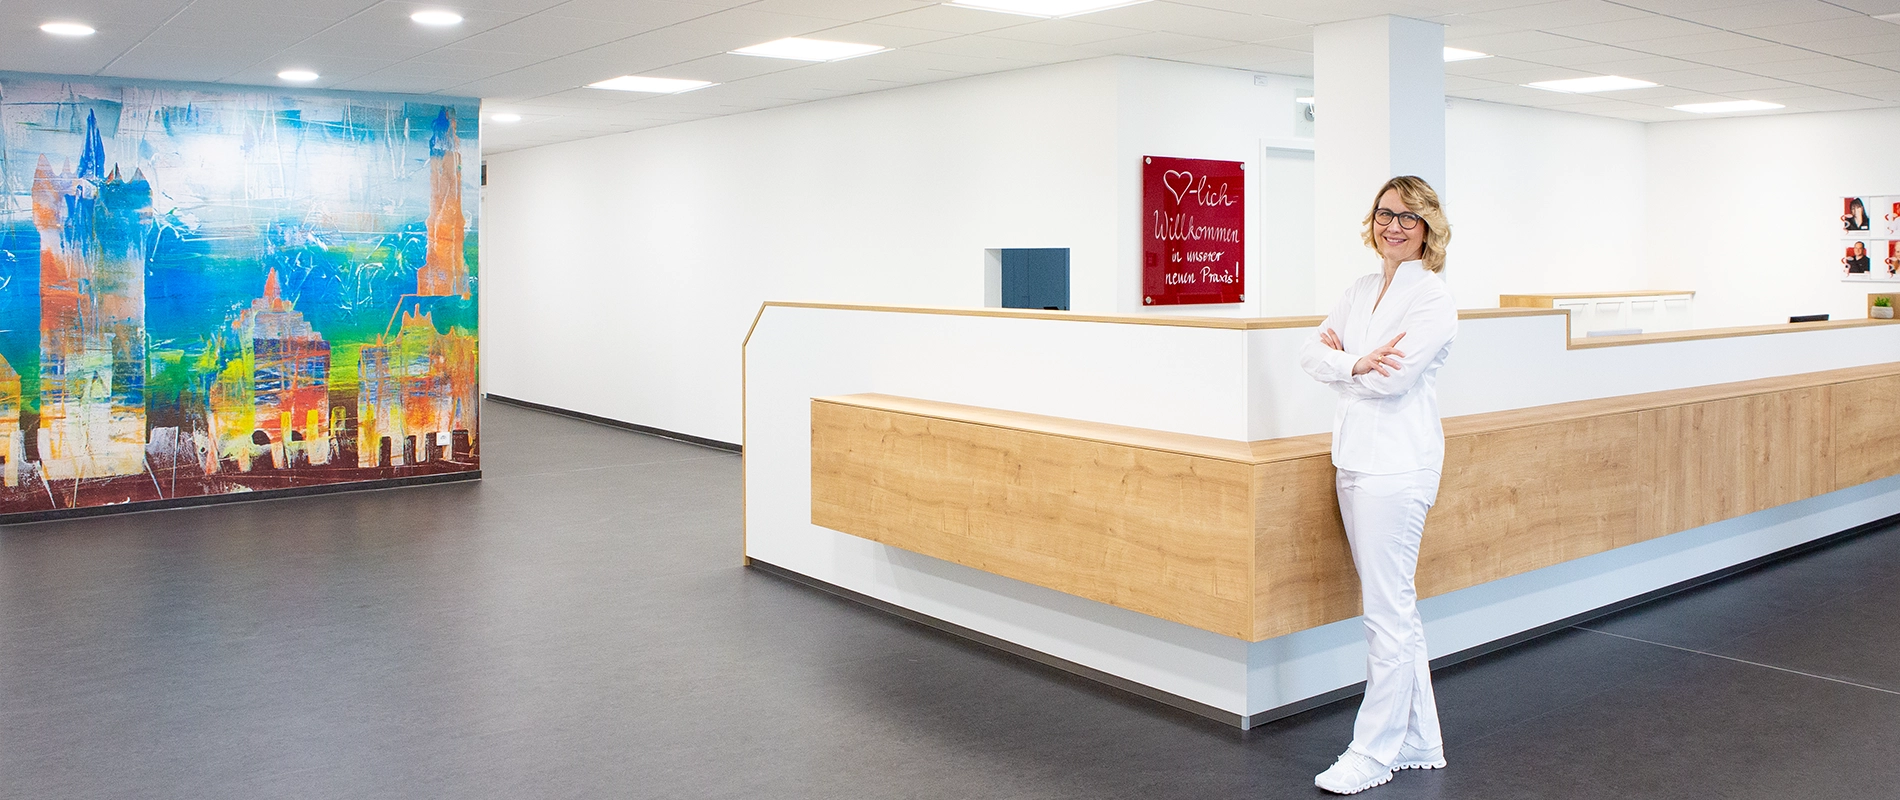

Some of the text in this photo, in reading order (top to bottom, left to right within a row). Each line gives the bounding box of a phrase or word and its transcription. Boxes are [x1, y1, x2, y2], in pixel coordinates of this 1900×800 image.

[1154, 209, 1240, 243] Willkommen
[1171, 248, 1225, 263] in unserer
[1165, 261, 1239, 285] neuen Praxis!
